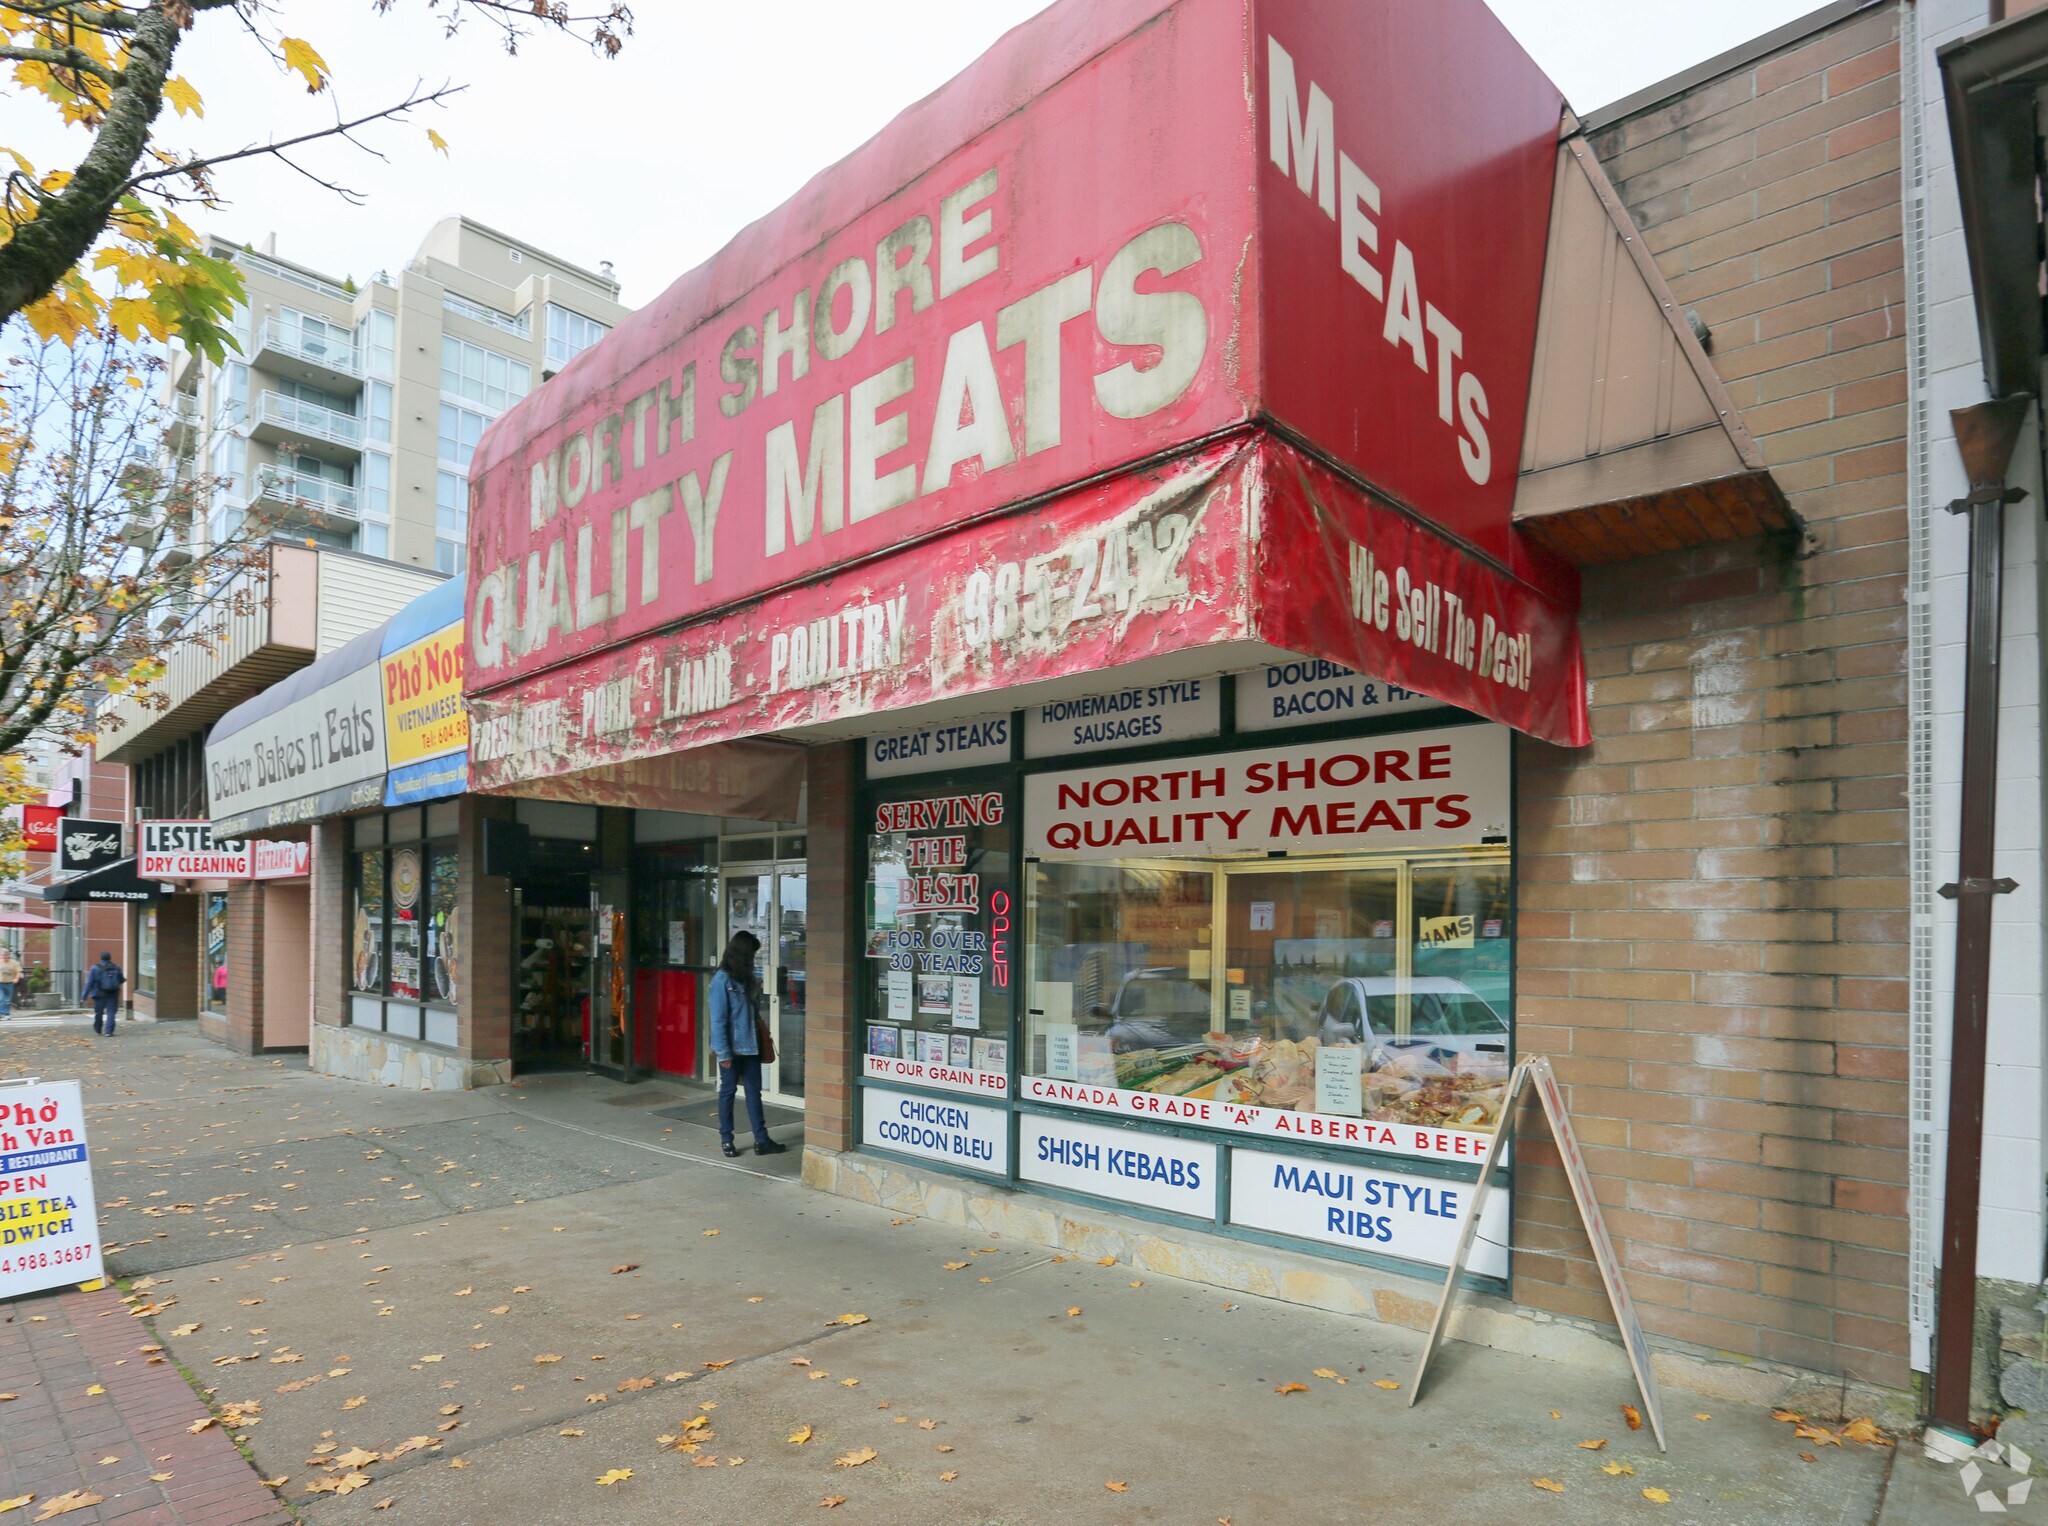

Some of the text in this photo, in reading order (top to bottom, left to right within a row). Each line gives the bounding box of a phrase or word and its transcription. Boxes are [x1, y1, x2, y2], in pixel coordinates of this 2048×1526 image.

[1268, 34, 1491, 485] MEATS
[531, 168, 998, 533] NORTH SHORE
[472, 221, 1208, 669] QUALITY MEATS
[1349, 540, 1532, 693] We Sell The Best!
[582, 675, 634, 739] PORK
[662, 650, 733, 721] LAMB
[770, 595, 907, 695] POULTRY
[397, 694, 458, 733] VIETNAMESE
[1042, 680, 1201, 723] HOMEMADE STYLE
[1273, 685, 1354, 718] BACON
[1362, 684, 1379, 705] &
[874, 719, 1007, 762] GREAT STEAKS
[1073, 715, 1162, 745] SAUSAGES
[212, 757, 251, 801] Better
[254, 734, 305, 788] Bakes
[325, 702, 375, 764] Eats
[1058, 744, 1451, 810] NORTH SHORE
[876, 792, 1003, 833] SERVING
[1046, 794, 1472, 850] QUALITY MEATS
[145, 857, 246, 873] DRY CLEANING
[906, 835, 967, 868] THE
[896, 873, 979, 906] BEST!
[887, 930, 987, 951] FOR OVER
[991, 890, 1011, 988] OPEN
[1421, 916, 1473, 948] HAMS
[890, 953, 984, 974] 30 YEARS
[869, 1058, 1006, 1089] TRY OUR GRAIN FED
[899, 1100, 969, 1131] CHICKEN
[1032, 1081, 1488, 1156] CANADA GRADE "A" ALBERTA BEEF
[25, 1127, 74, 1148] Van
[879, 1121, 993, 1162] CORDON BLEU
[8, 1147, 78, 1170] RESTAURANT
[1037, 1135, 1201, 1190] SHISH KEBABS
[37, 1195, 78, 1215] TEA
[1273, 1164, 1458, 1220] MAUI STYLE
[1327, 1206, 1393, 1242] RIBS
